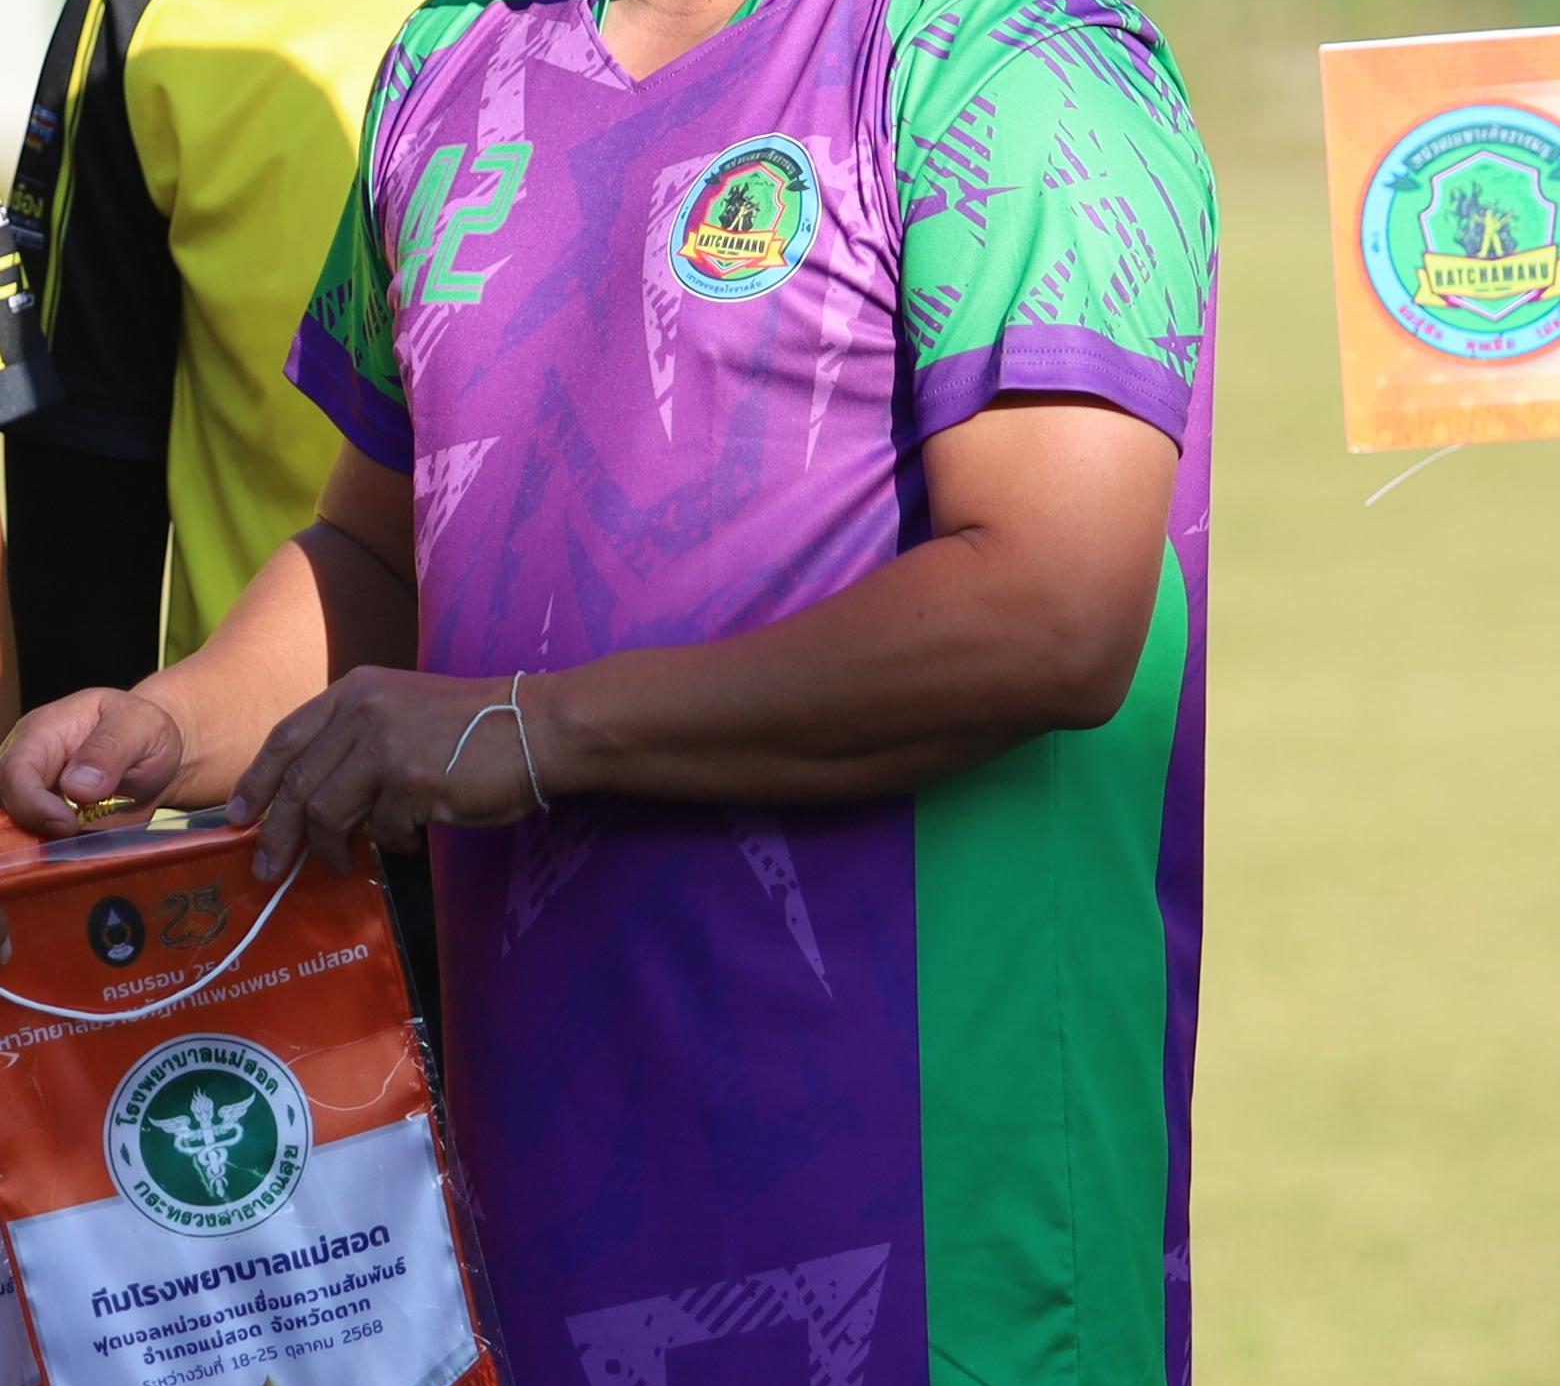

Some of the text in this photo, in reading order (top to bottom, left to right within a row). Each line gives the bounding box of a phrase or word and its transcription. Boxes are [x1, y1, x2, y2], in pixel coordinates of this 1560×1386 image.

[102, 969, 185, 1002] ครบรอบ
[296, 943, 369, 977] แม่สอด
[115, 1046, 279, 1128] โรงพยาบาลแม่สอด
[132, 1145, 301, 1228] กระทรวงสาธารณสุข
[91, 1224, 391, 1318] ทีมโรงพยาบาลแม่สอด
[93, 1256, 408, 1357] ฟุตบอลหน่วยงานเชื่อมความสัมพันธ์
[142, 1297, 372, 1365] อำเภอแม่สอด จังหวัดตาก
[230, 1345, 279, 1370] 18-25
[284, 1336, 335, 1361] ตุลาคม
[340, 1319, 384, 1345] 2568
